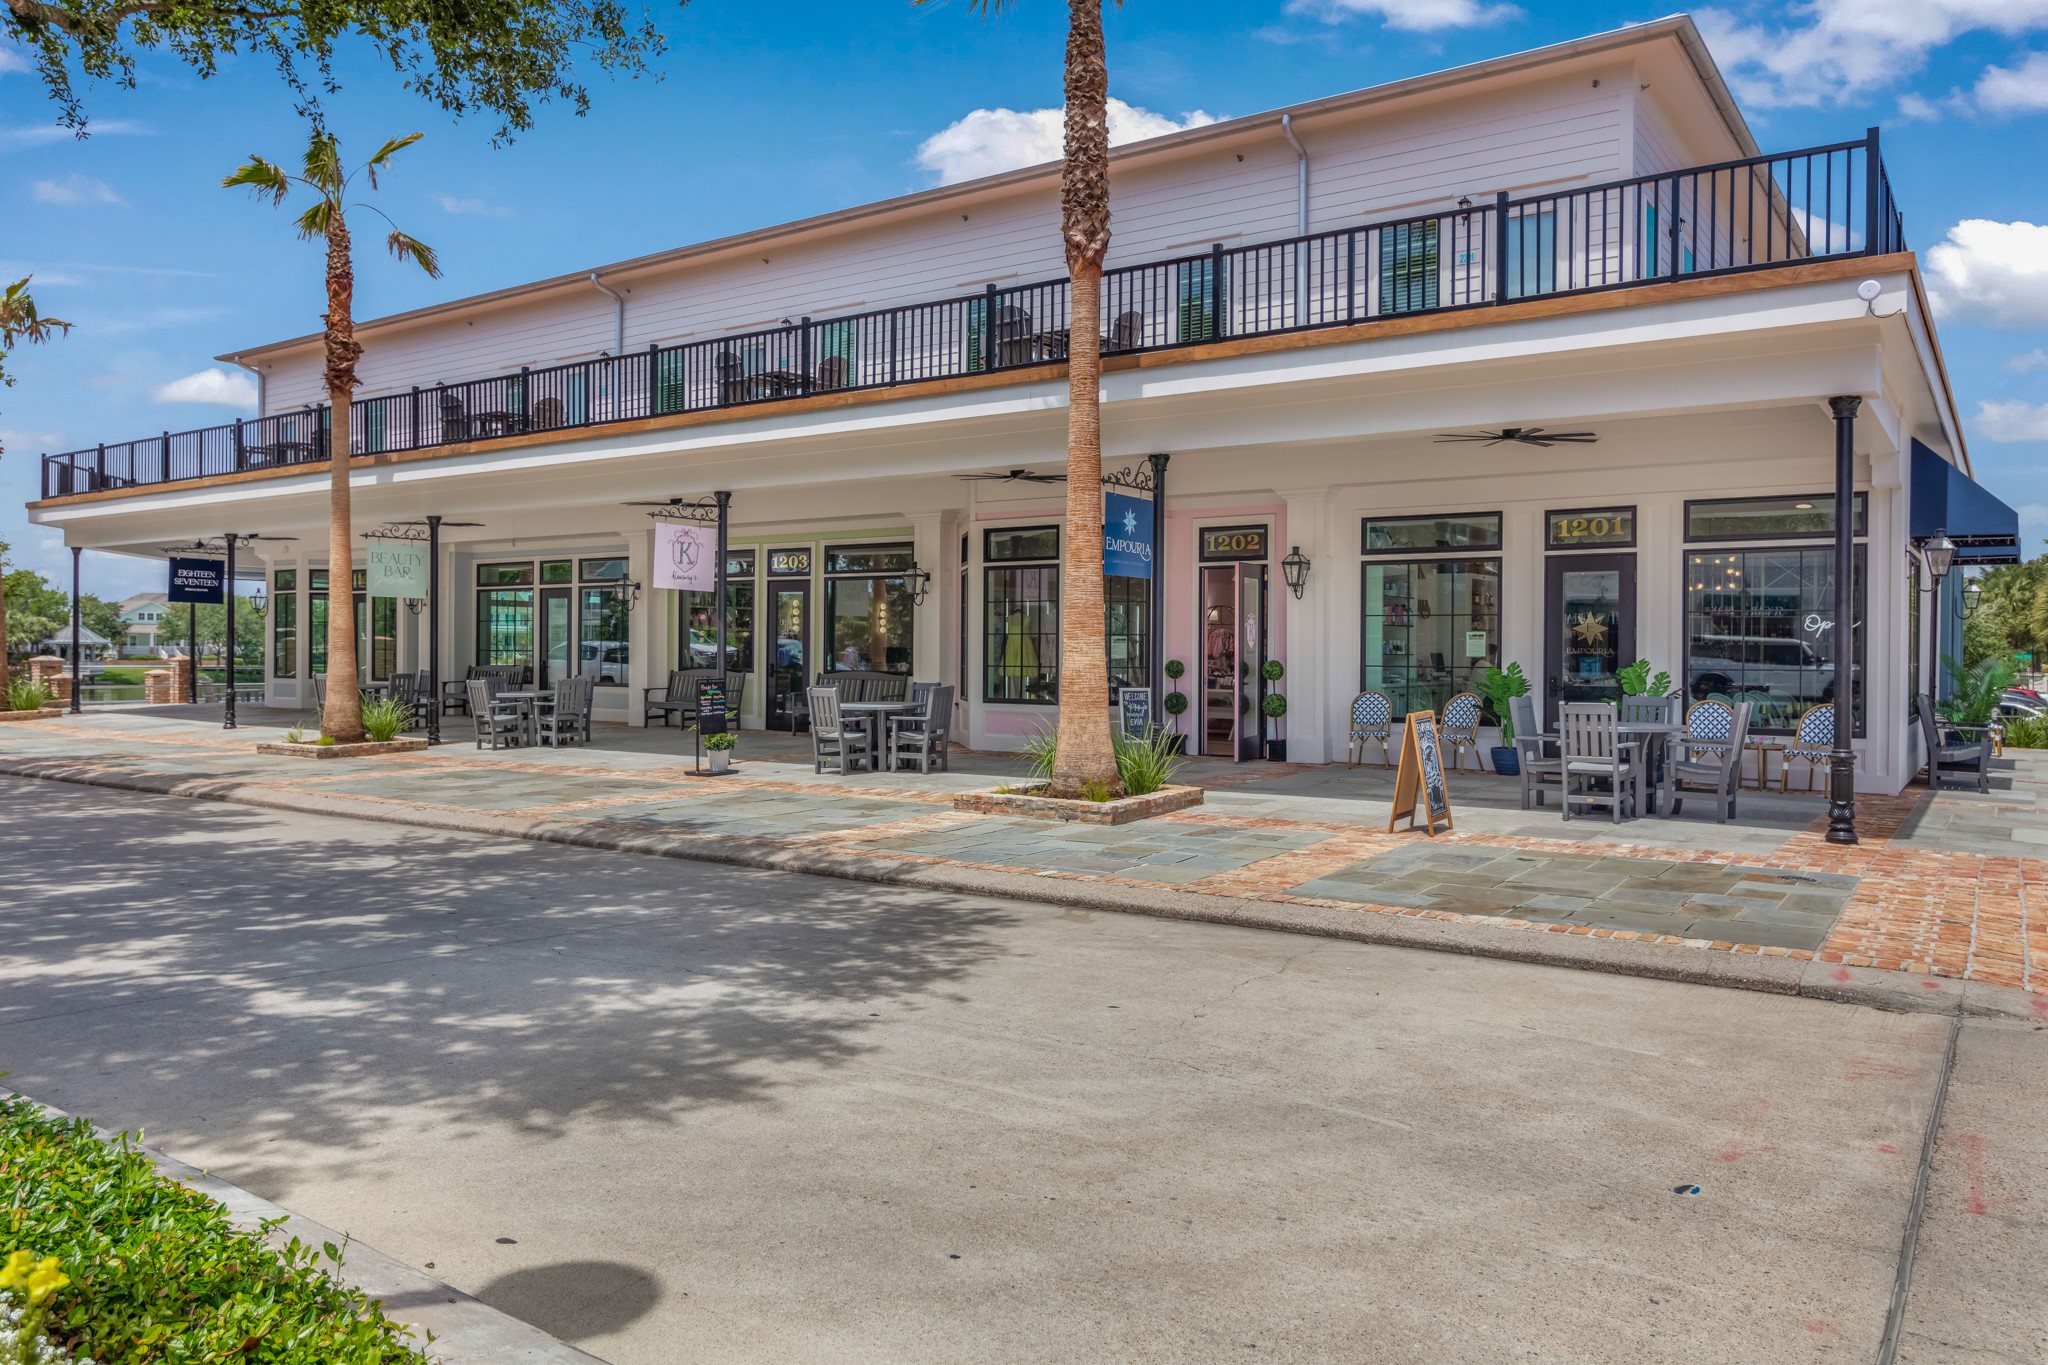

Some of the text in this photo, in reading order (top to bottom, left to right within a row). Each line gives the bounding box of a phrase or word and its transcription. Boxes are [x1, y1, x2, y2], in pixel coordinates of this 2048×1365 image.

[1558, 516, 1625, 538] 1201
[1106, 536, 1152, 561] EMPOURIA
[1207, 533, 1260, 552] 1202
[371, 551, 425, 566] BEAUTY
[677, 541, 694, 565] K
[772, 554, 808, 569] 1203
[177, 569, 216, 578] EIGHTEEN
[384, 565, 413, 579] BAR
[174, 577, 219, 586] SEVENTEEN
[1123, 692, 1147, 700] WELCOME
